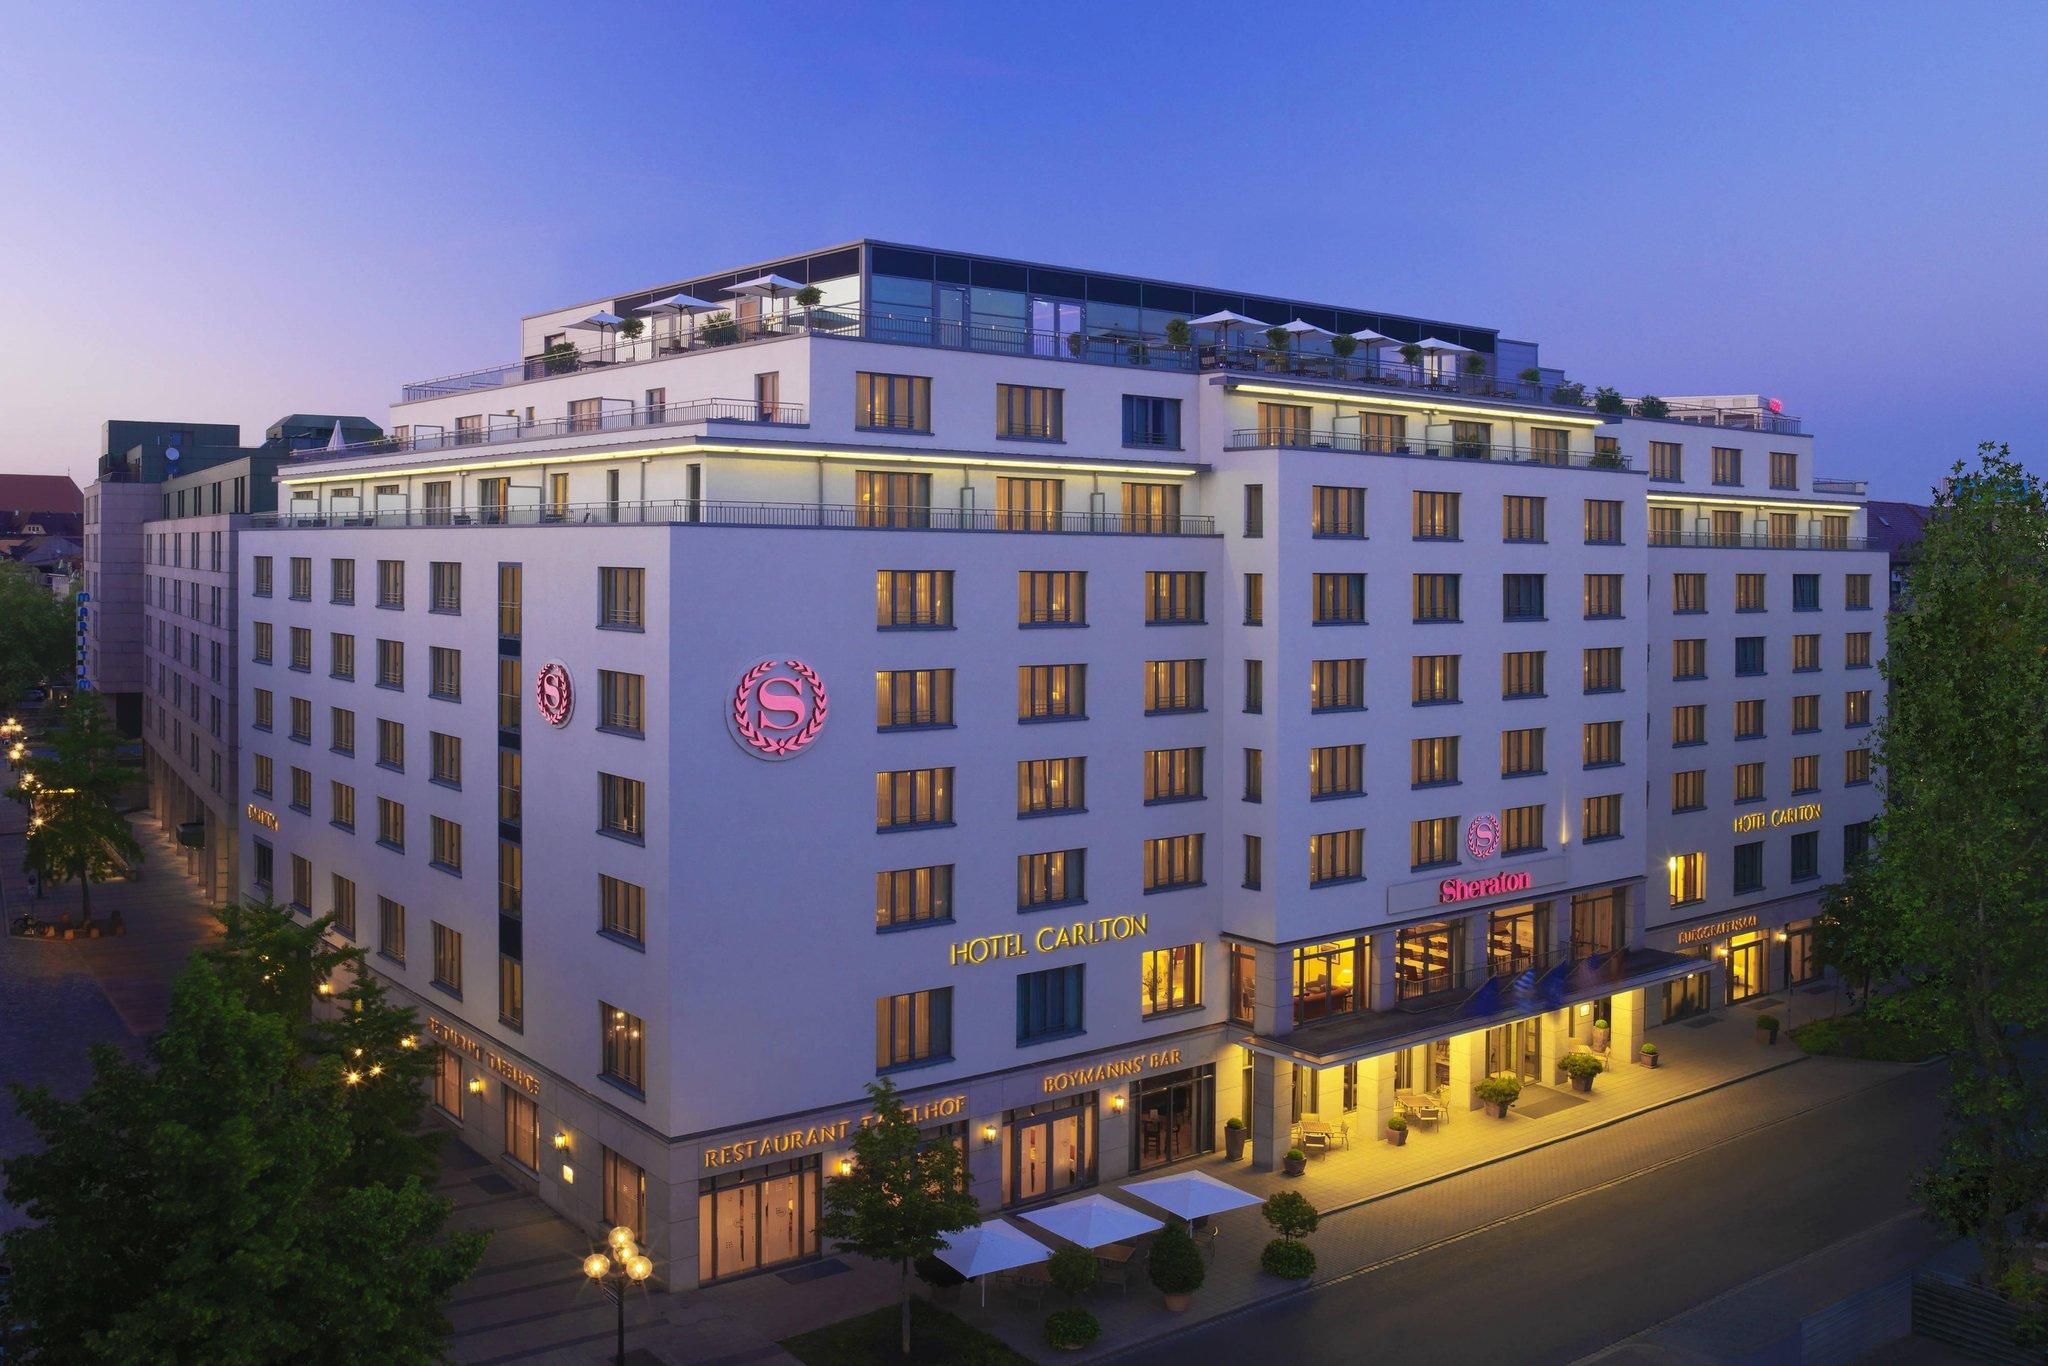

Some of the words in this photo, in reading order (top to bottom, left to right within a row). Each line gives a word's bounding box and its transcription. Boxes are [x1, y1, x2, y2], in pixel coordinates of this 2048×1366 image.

[758, 677, 806, 730] S
[1475, 822, 1494, 847] S
[1733, 812, 1766, 833] HOTEL
[1771, 803, 1822, 828] CARLTON
[1440, 871, 1532, 904] Sheraton
[950, 932, 1029, 967] HOTEL
[1036, 913, 1149, 953] CARLTON
[1043, 1055, 1146, 1094] BOYMANNS'
[1149, 1048, 1182, 1069] BAR
[703, 1119, 852, 1169] RESTAURANT
[861, 1095, 968, 1130] TAELHOF
